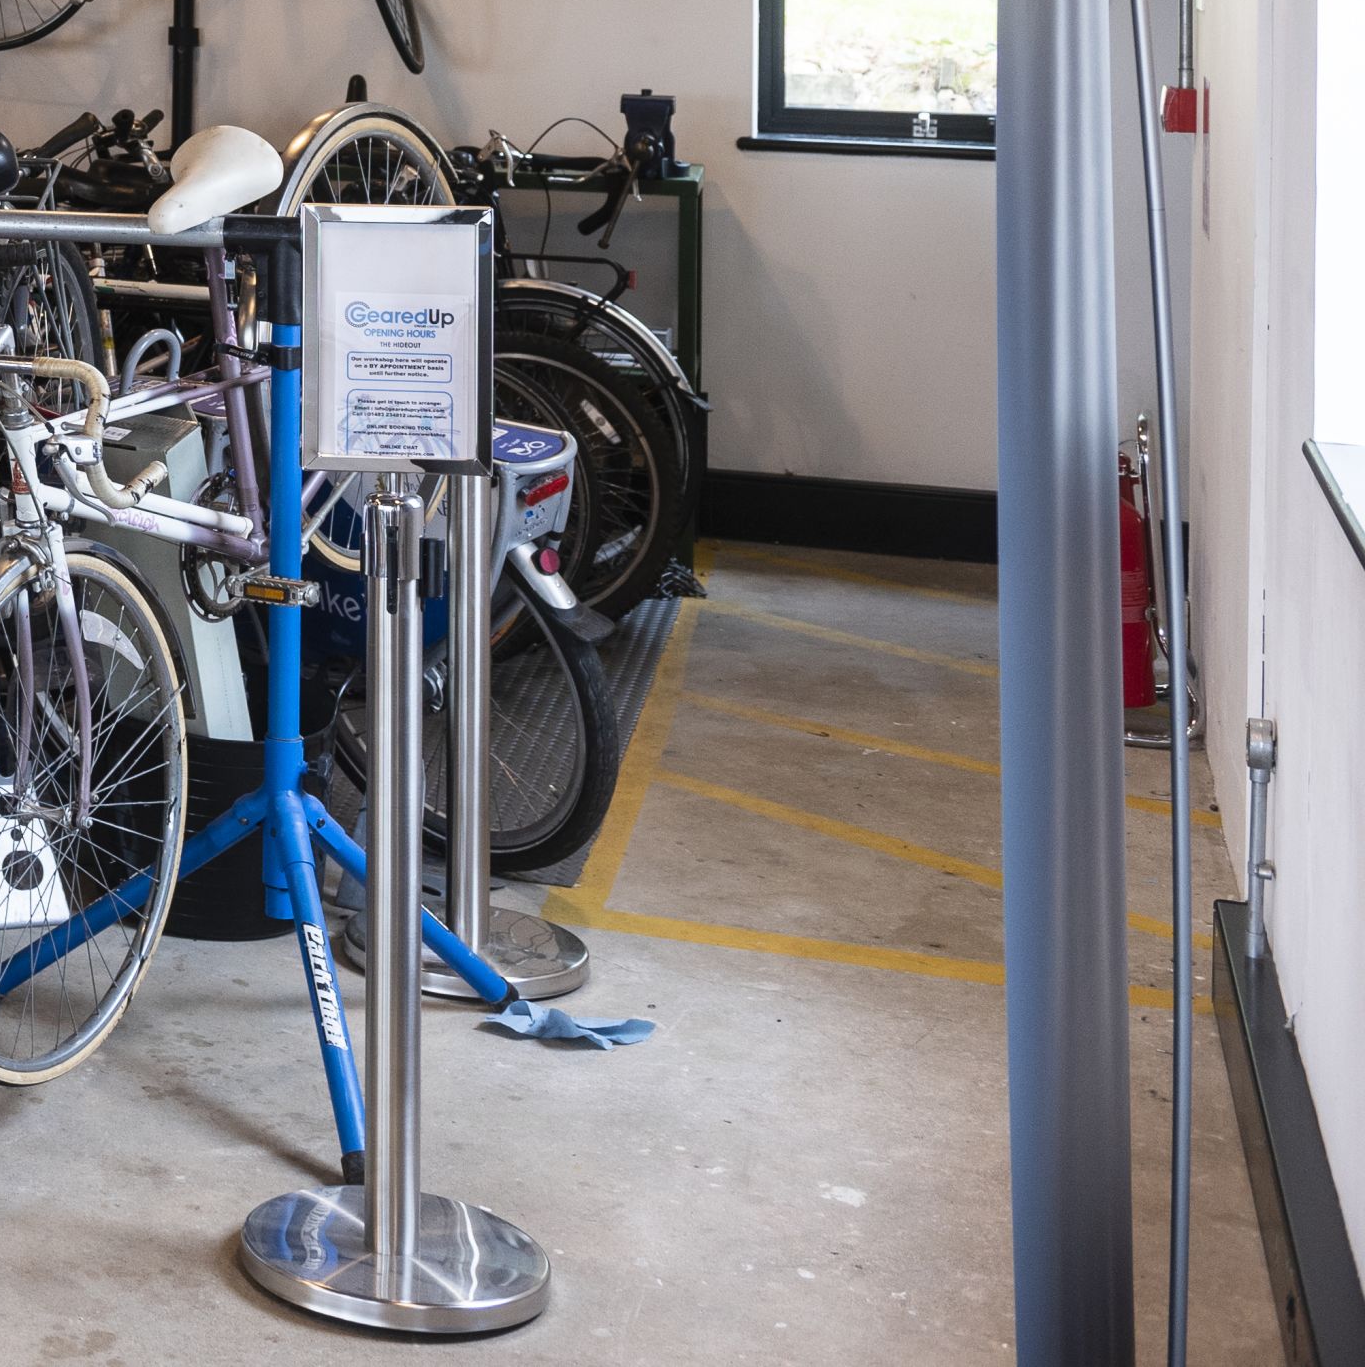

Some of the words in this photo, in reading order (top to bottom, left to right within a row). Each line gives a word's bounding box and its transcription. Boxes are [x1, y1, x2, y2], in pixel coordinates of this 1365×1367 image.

[345, 301, 455, 328] GearedUp
[364, 328, 404, 337] OPENING
[406, 329, 436, 338] HOURS
